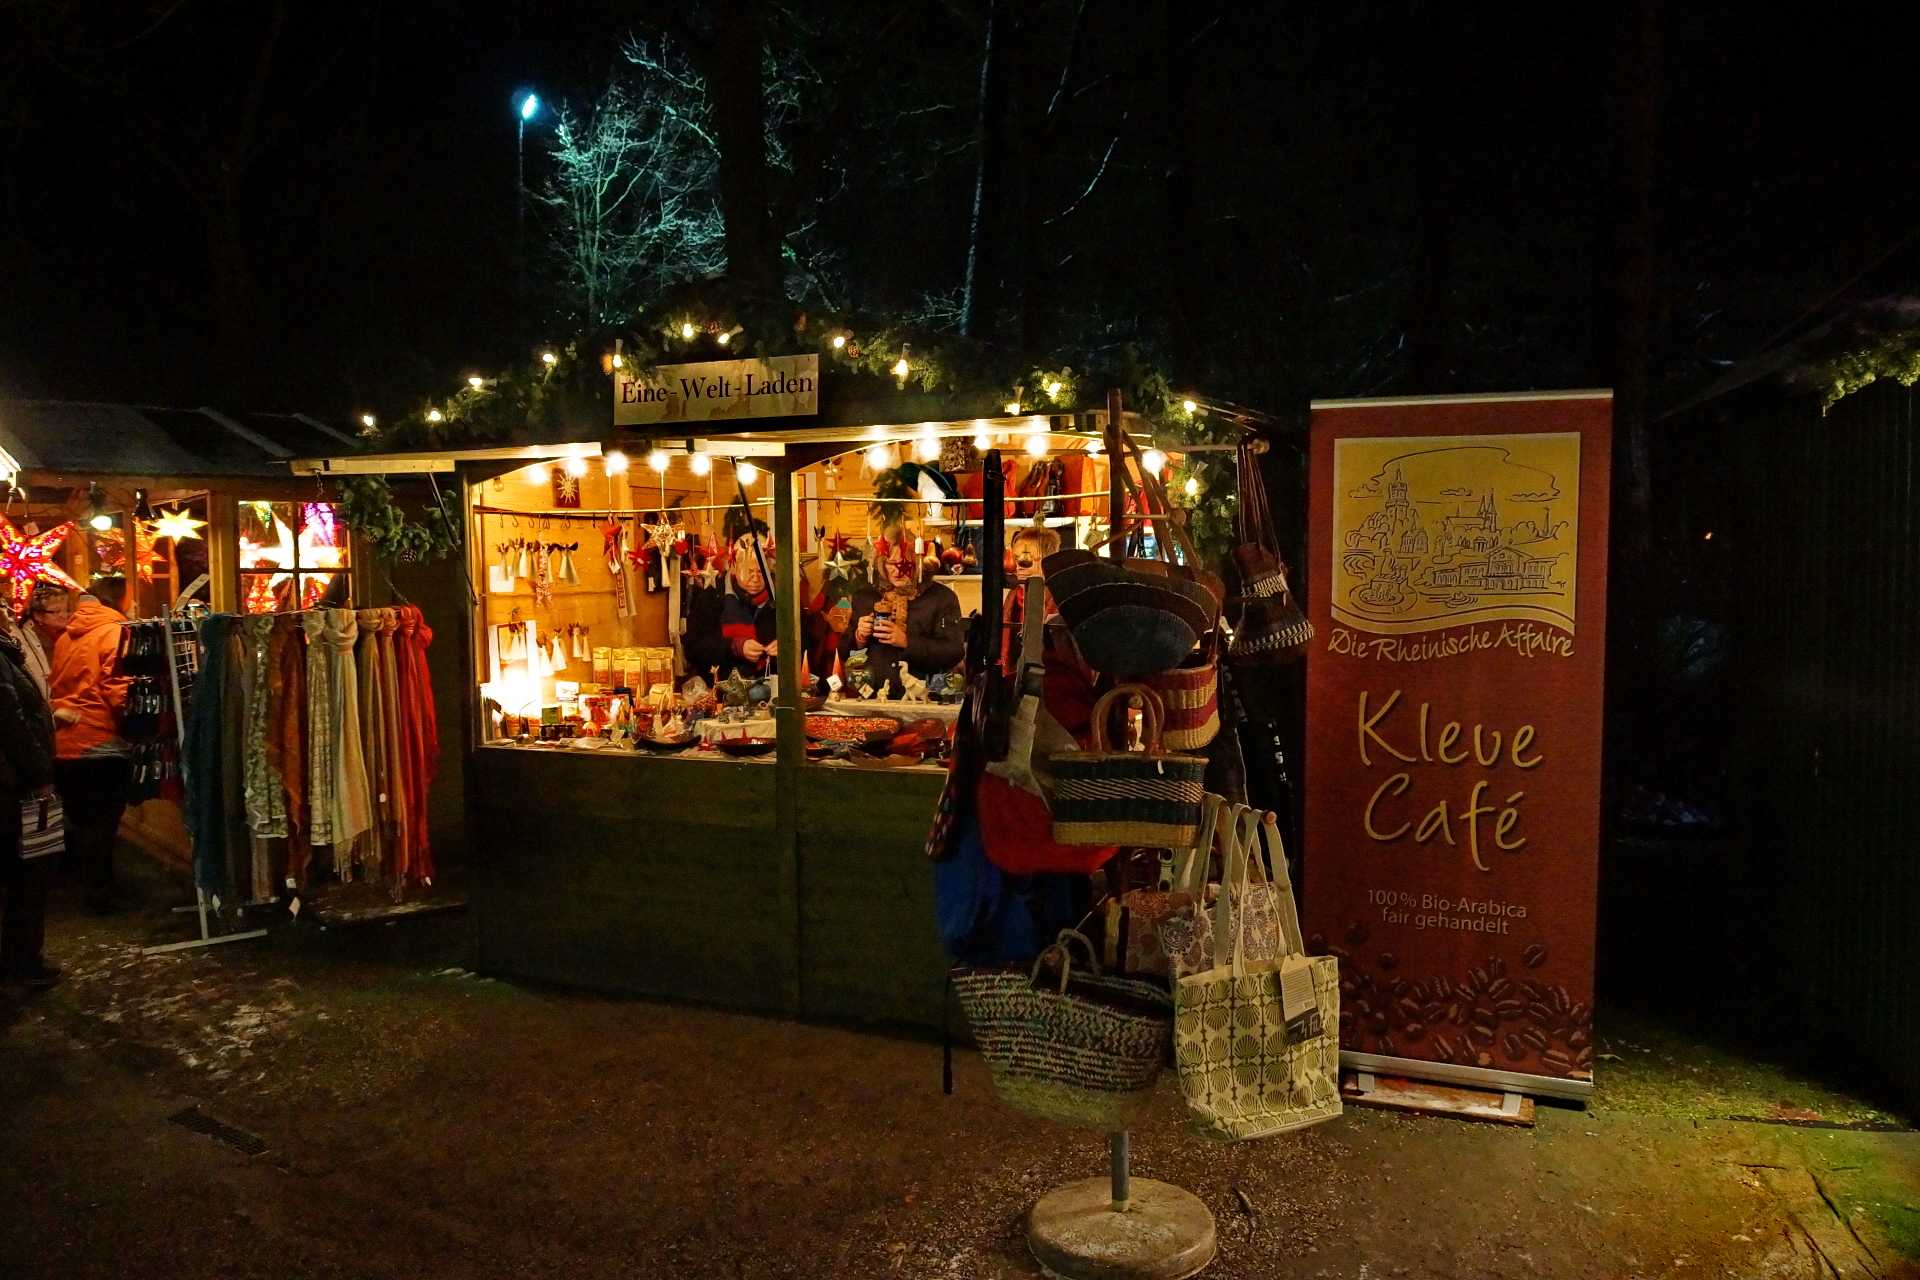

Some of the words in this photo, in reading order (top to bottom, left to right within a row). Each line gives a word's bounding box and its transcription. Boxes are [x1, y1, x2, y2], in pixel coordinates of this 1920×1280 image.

[621, 371, 812, 403] Eine-Welt-Laden
[1328, 628, 1368, 658] Die
[1370, 626, 1492, 662] Rheinische
[1494, 623, 1574, 658] Affaire
[1358, 689, 1543, 768] Kleve
[1364, 773, 1526, 871] Café
[1383, 907, 1410, 925] fair
[1415, 912, 1510, 935] gehandelt
[1422, 894, 1527, 919] Bio-Arabica
